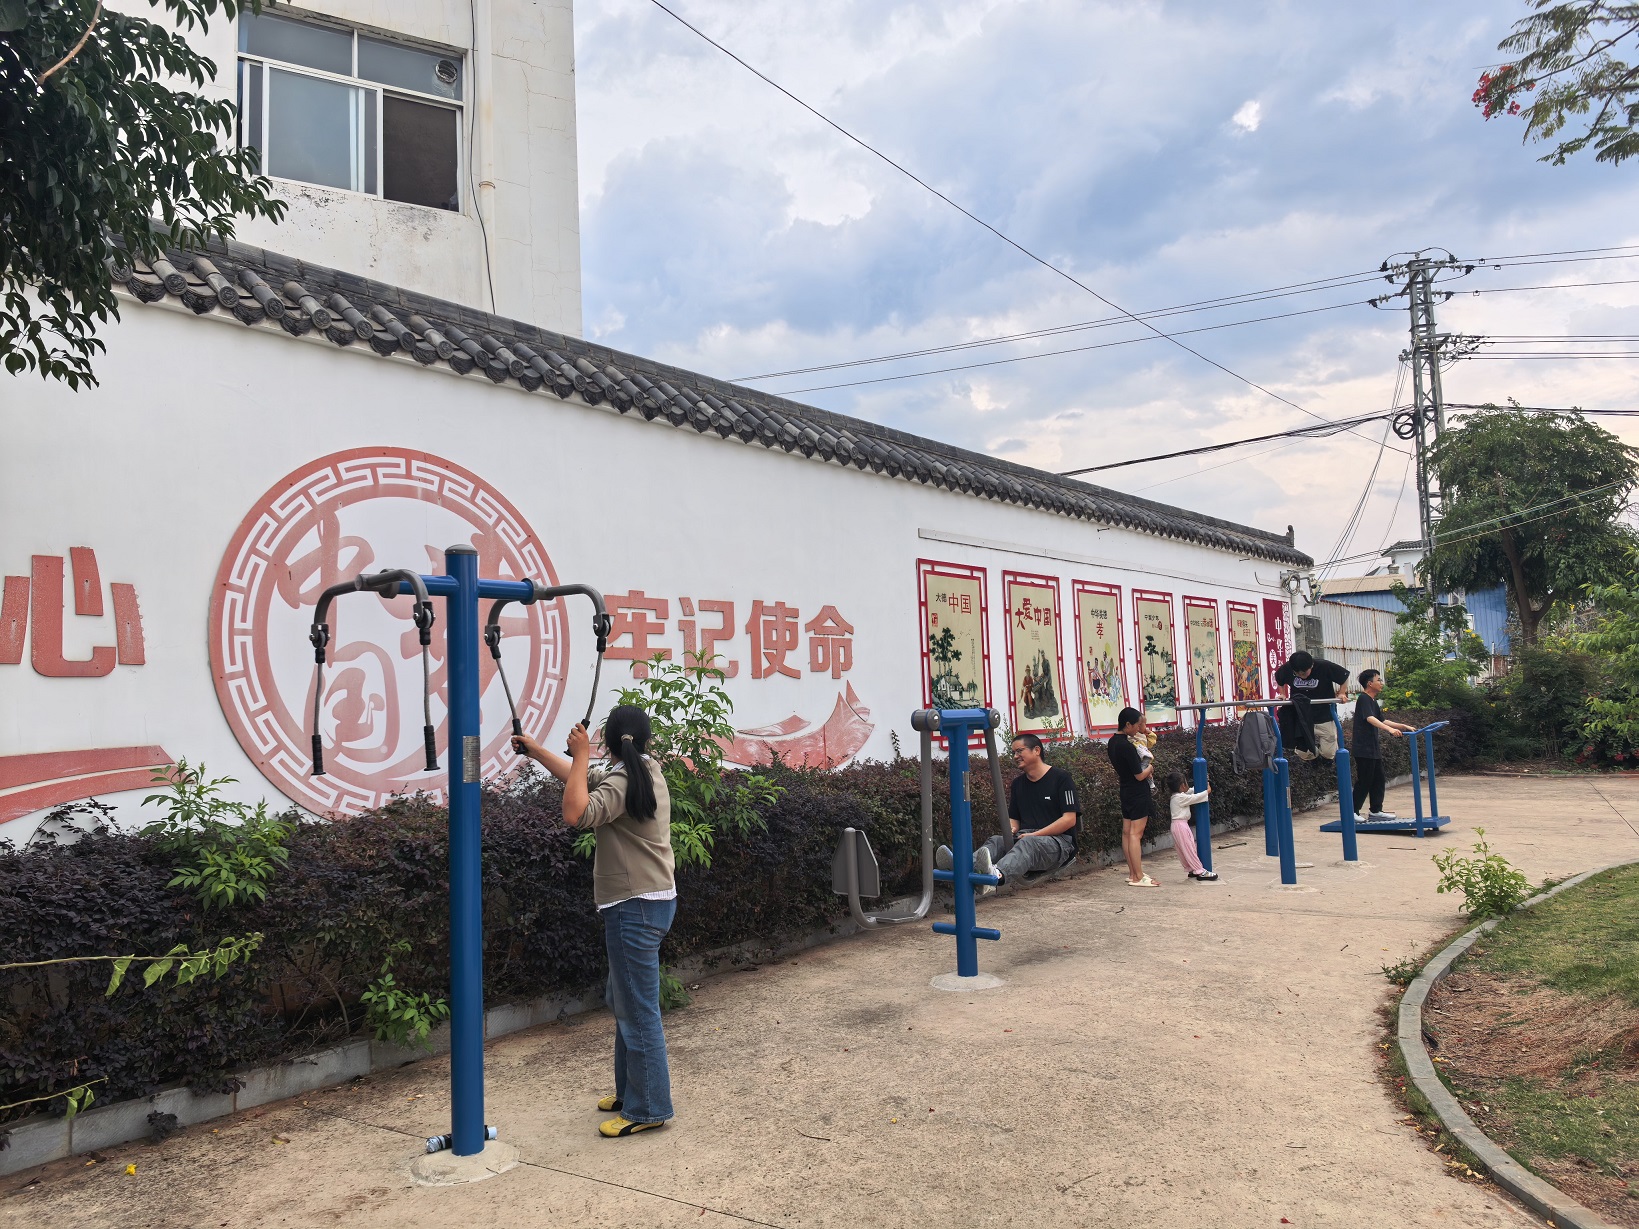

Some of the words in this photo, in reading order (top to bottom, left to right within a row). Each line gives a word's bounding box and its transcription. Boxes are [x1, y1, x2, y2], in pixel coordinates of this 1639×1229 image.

[0, 546, 145, 677] 心
[603, 590, 855, 679] 牢记使命
[1014, 597, 1053, 631] 大爱中国
